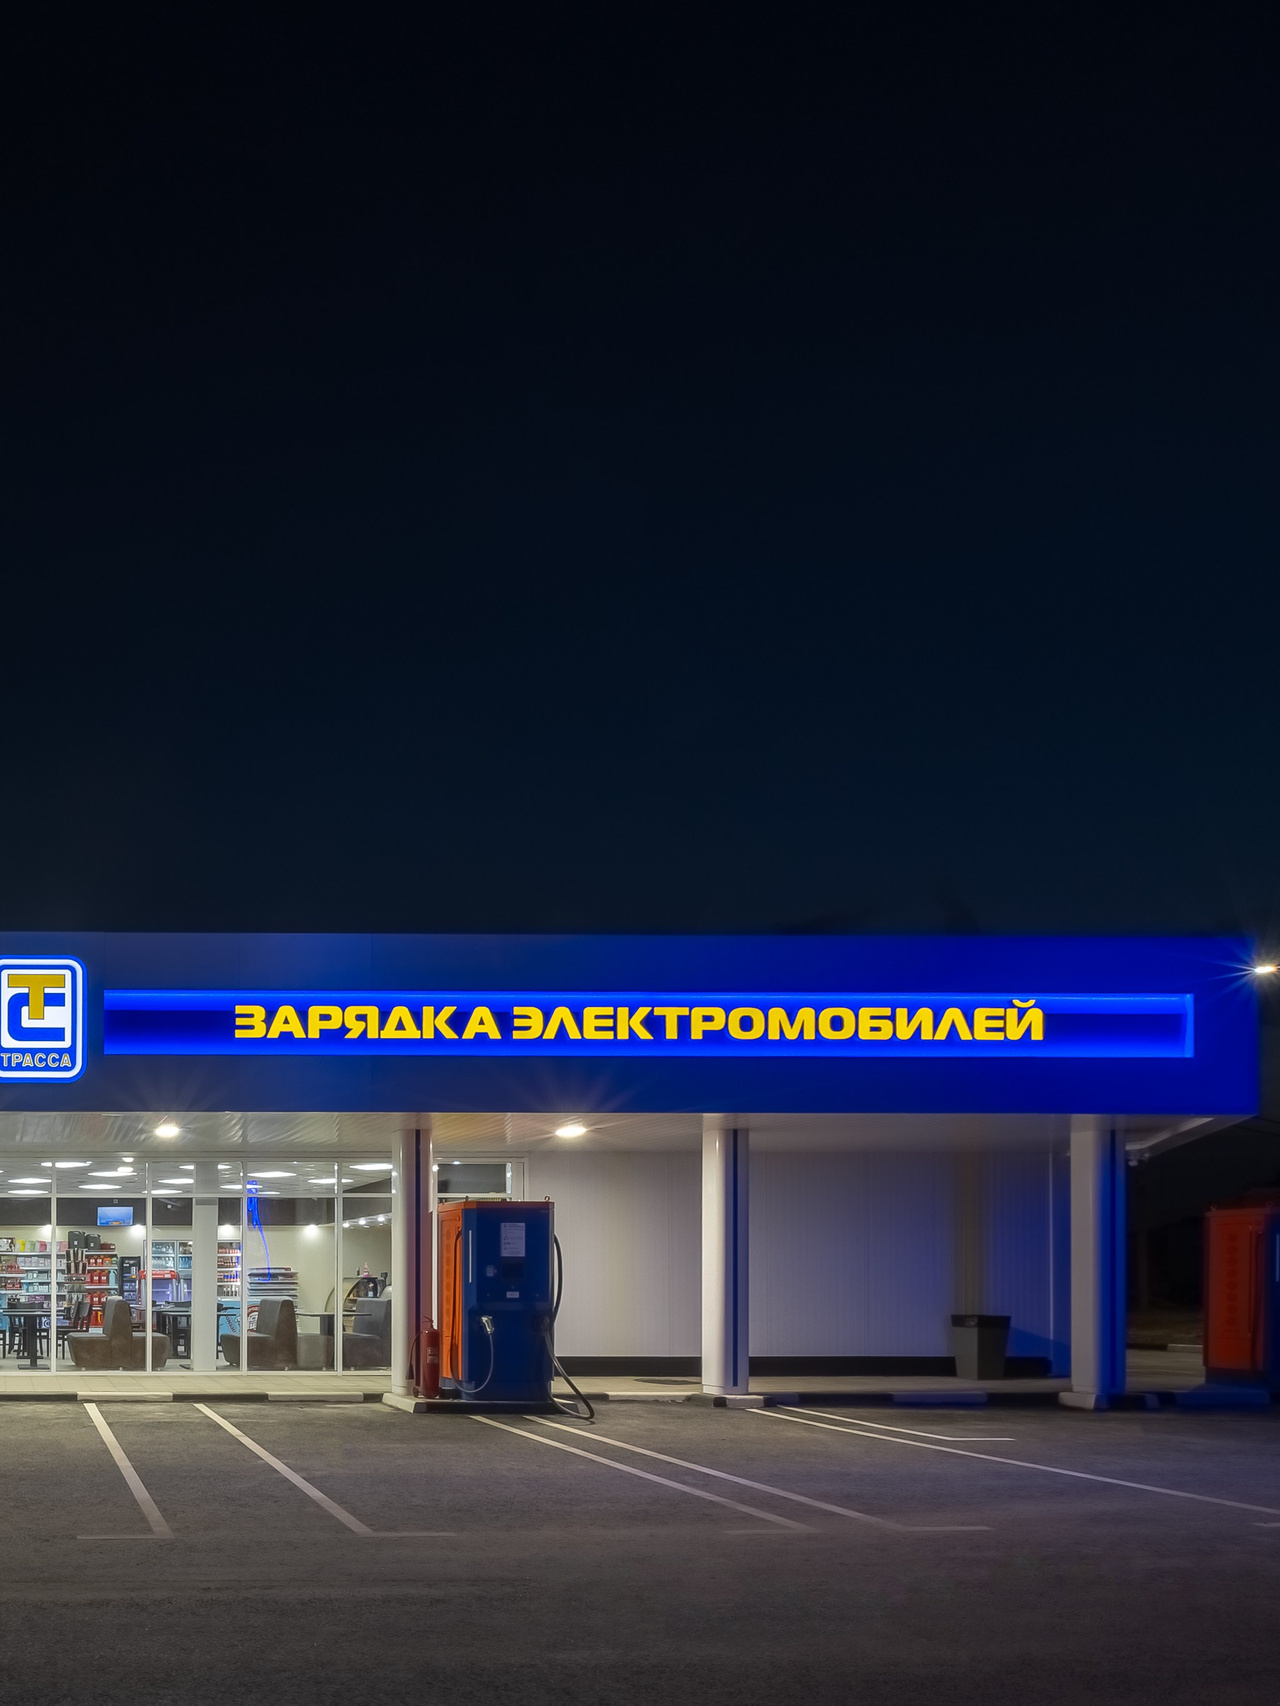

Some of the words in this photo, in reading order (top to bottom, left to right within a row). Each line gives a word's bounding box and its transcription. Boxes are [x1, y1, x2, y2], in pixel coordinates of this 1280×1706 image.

[234, 1004, 502, 1039] ЗАРЯДКА
[512, 999, 1044, 1041] ЭЛЕКТРОМОБИЛЕЙ
[0, 1053, 72, 1068] ТРАССА
